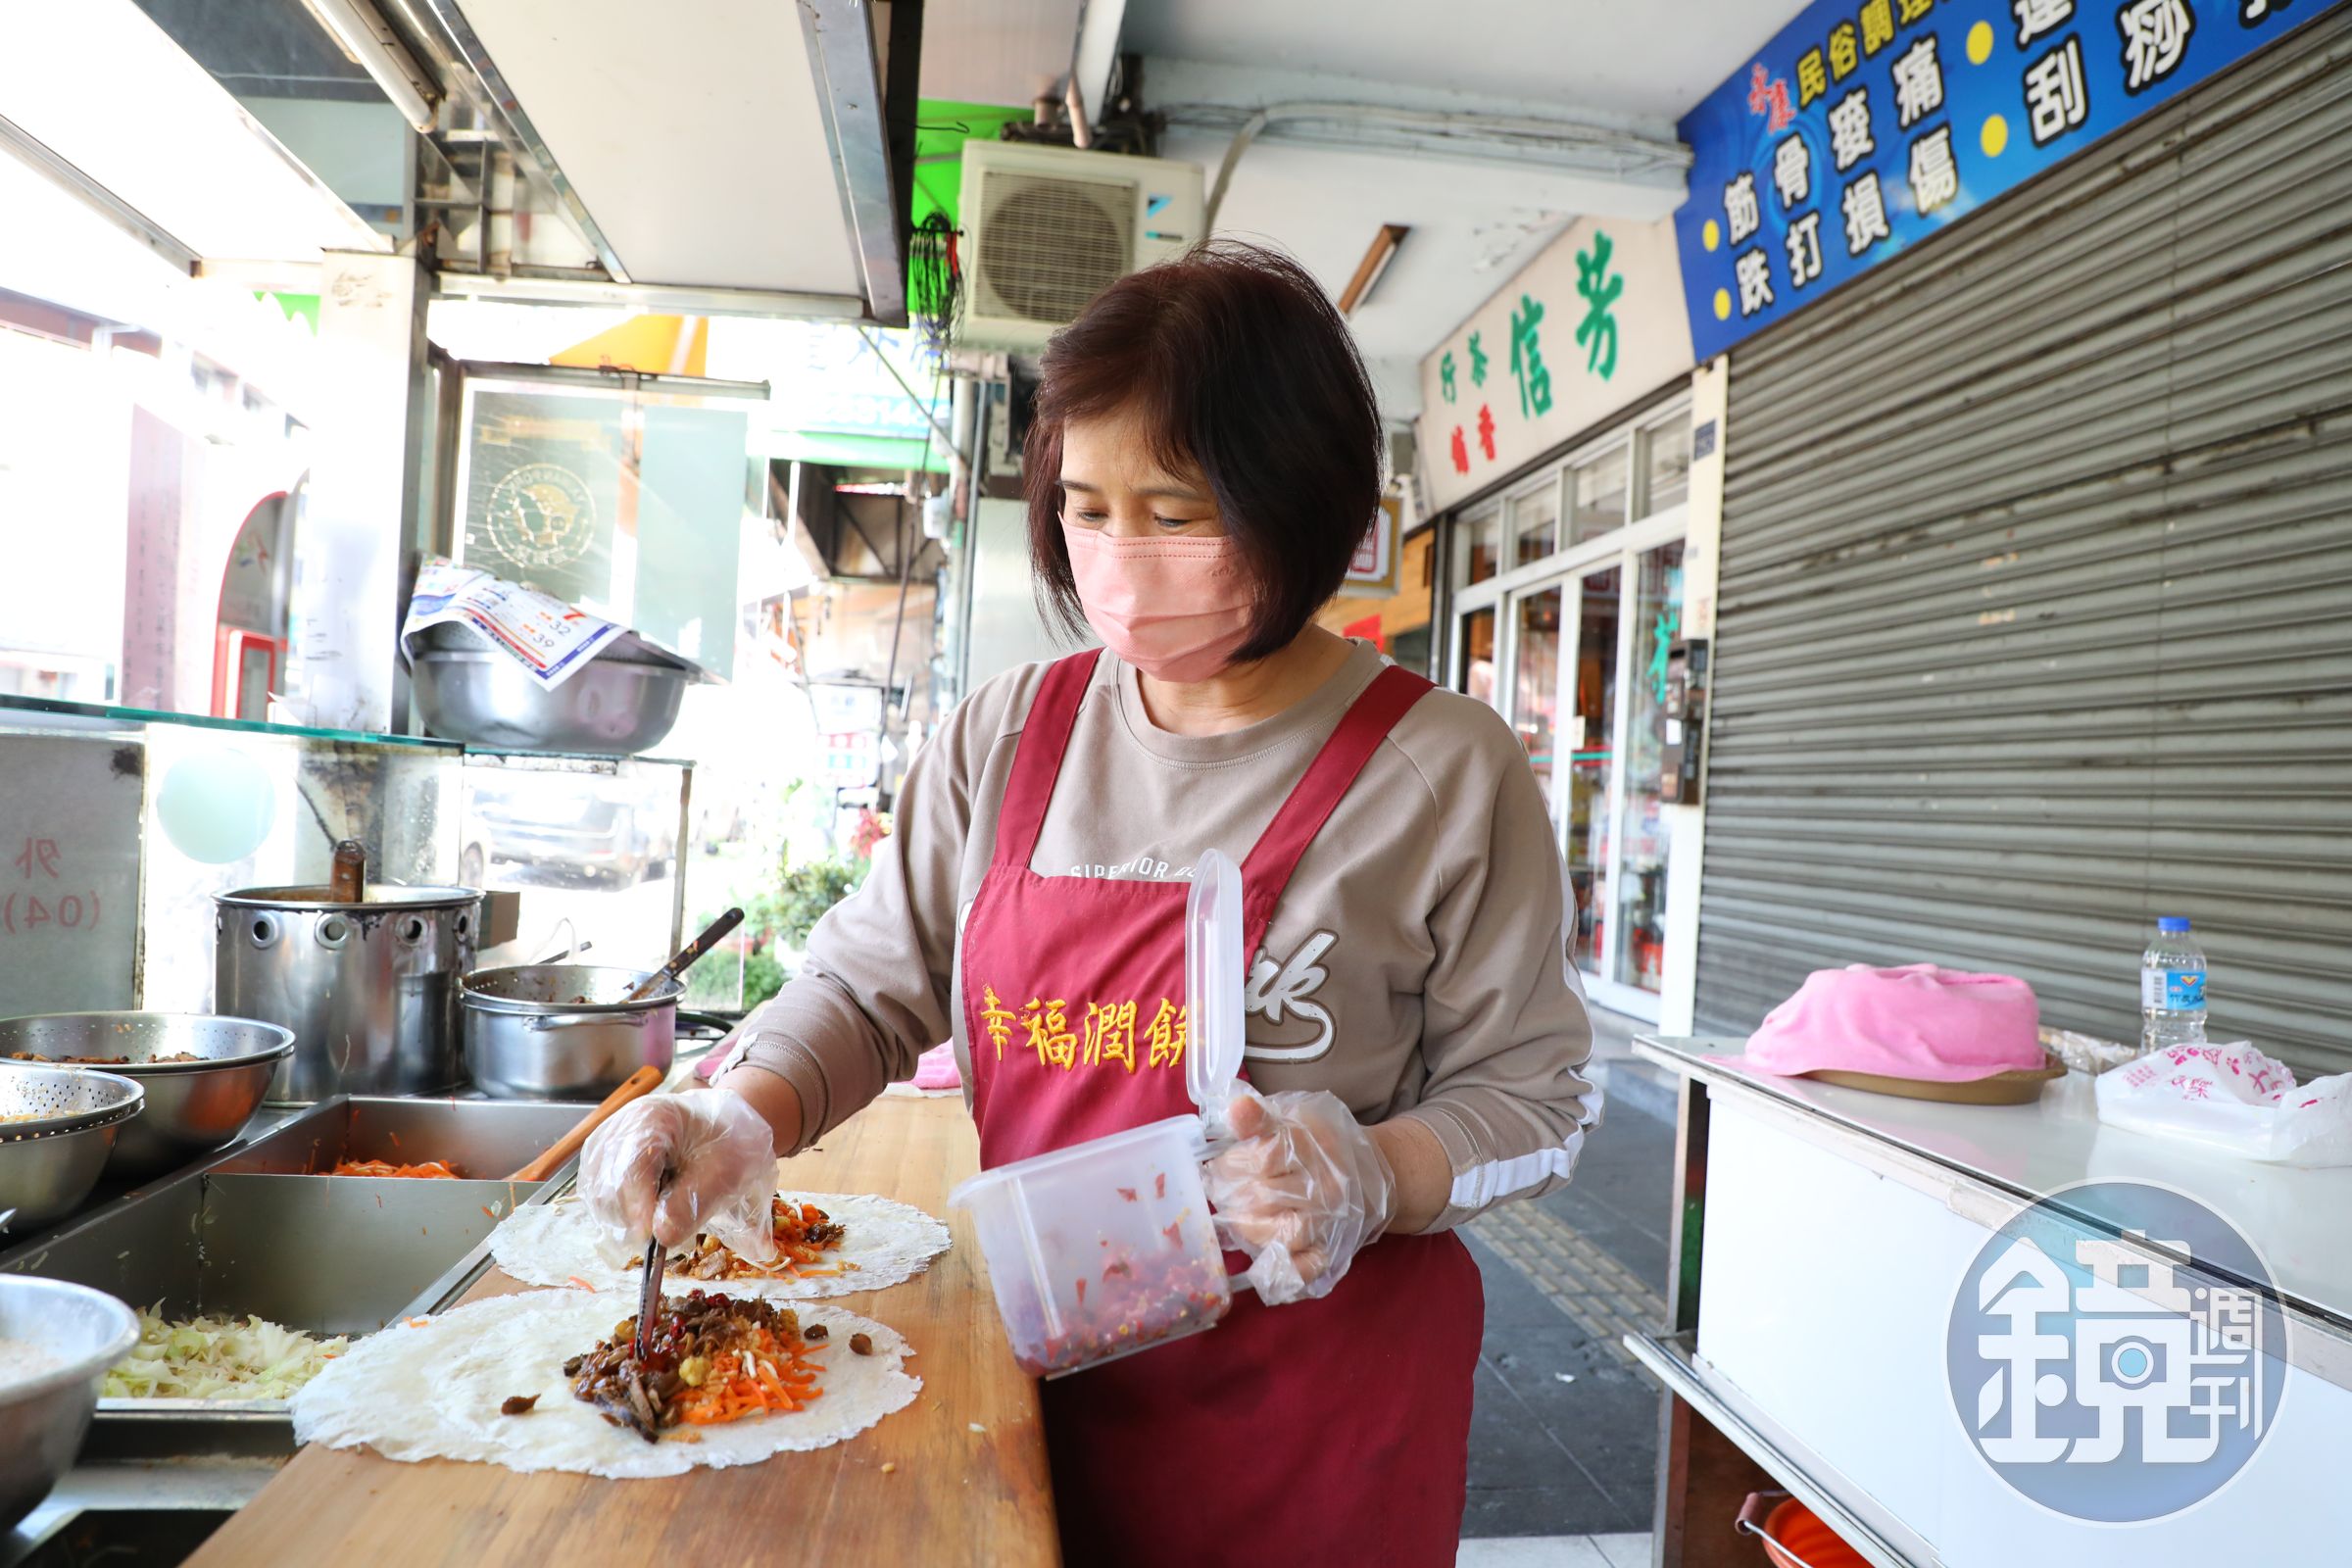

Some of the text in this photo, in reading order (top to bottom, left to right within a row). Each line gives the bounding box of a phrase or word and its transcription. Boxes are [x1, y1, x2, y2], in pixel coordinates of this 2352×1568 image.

[1723, 37, 1943, 245] 筋骨痠痛
[1736, 128, 1958, 316] 跌打損傷
